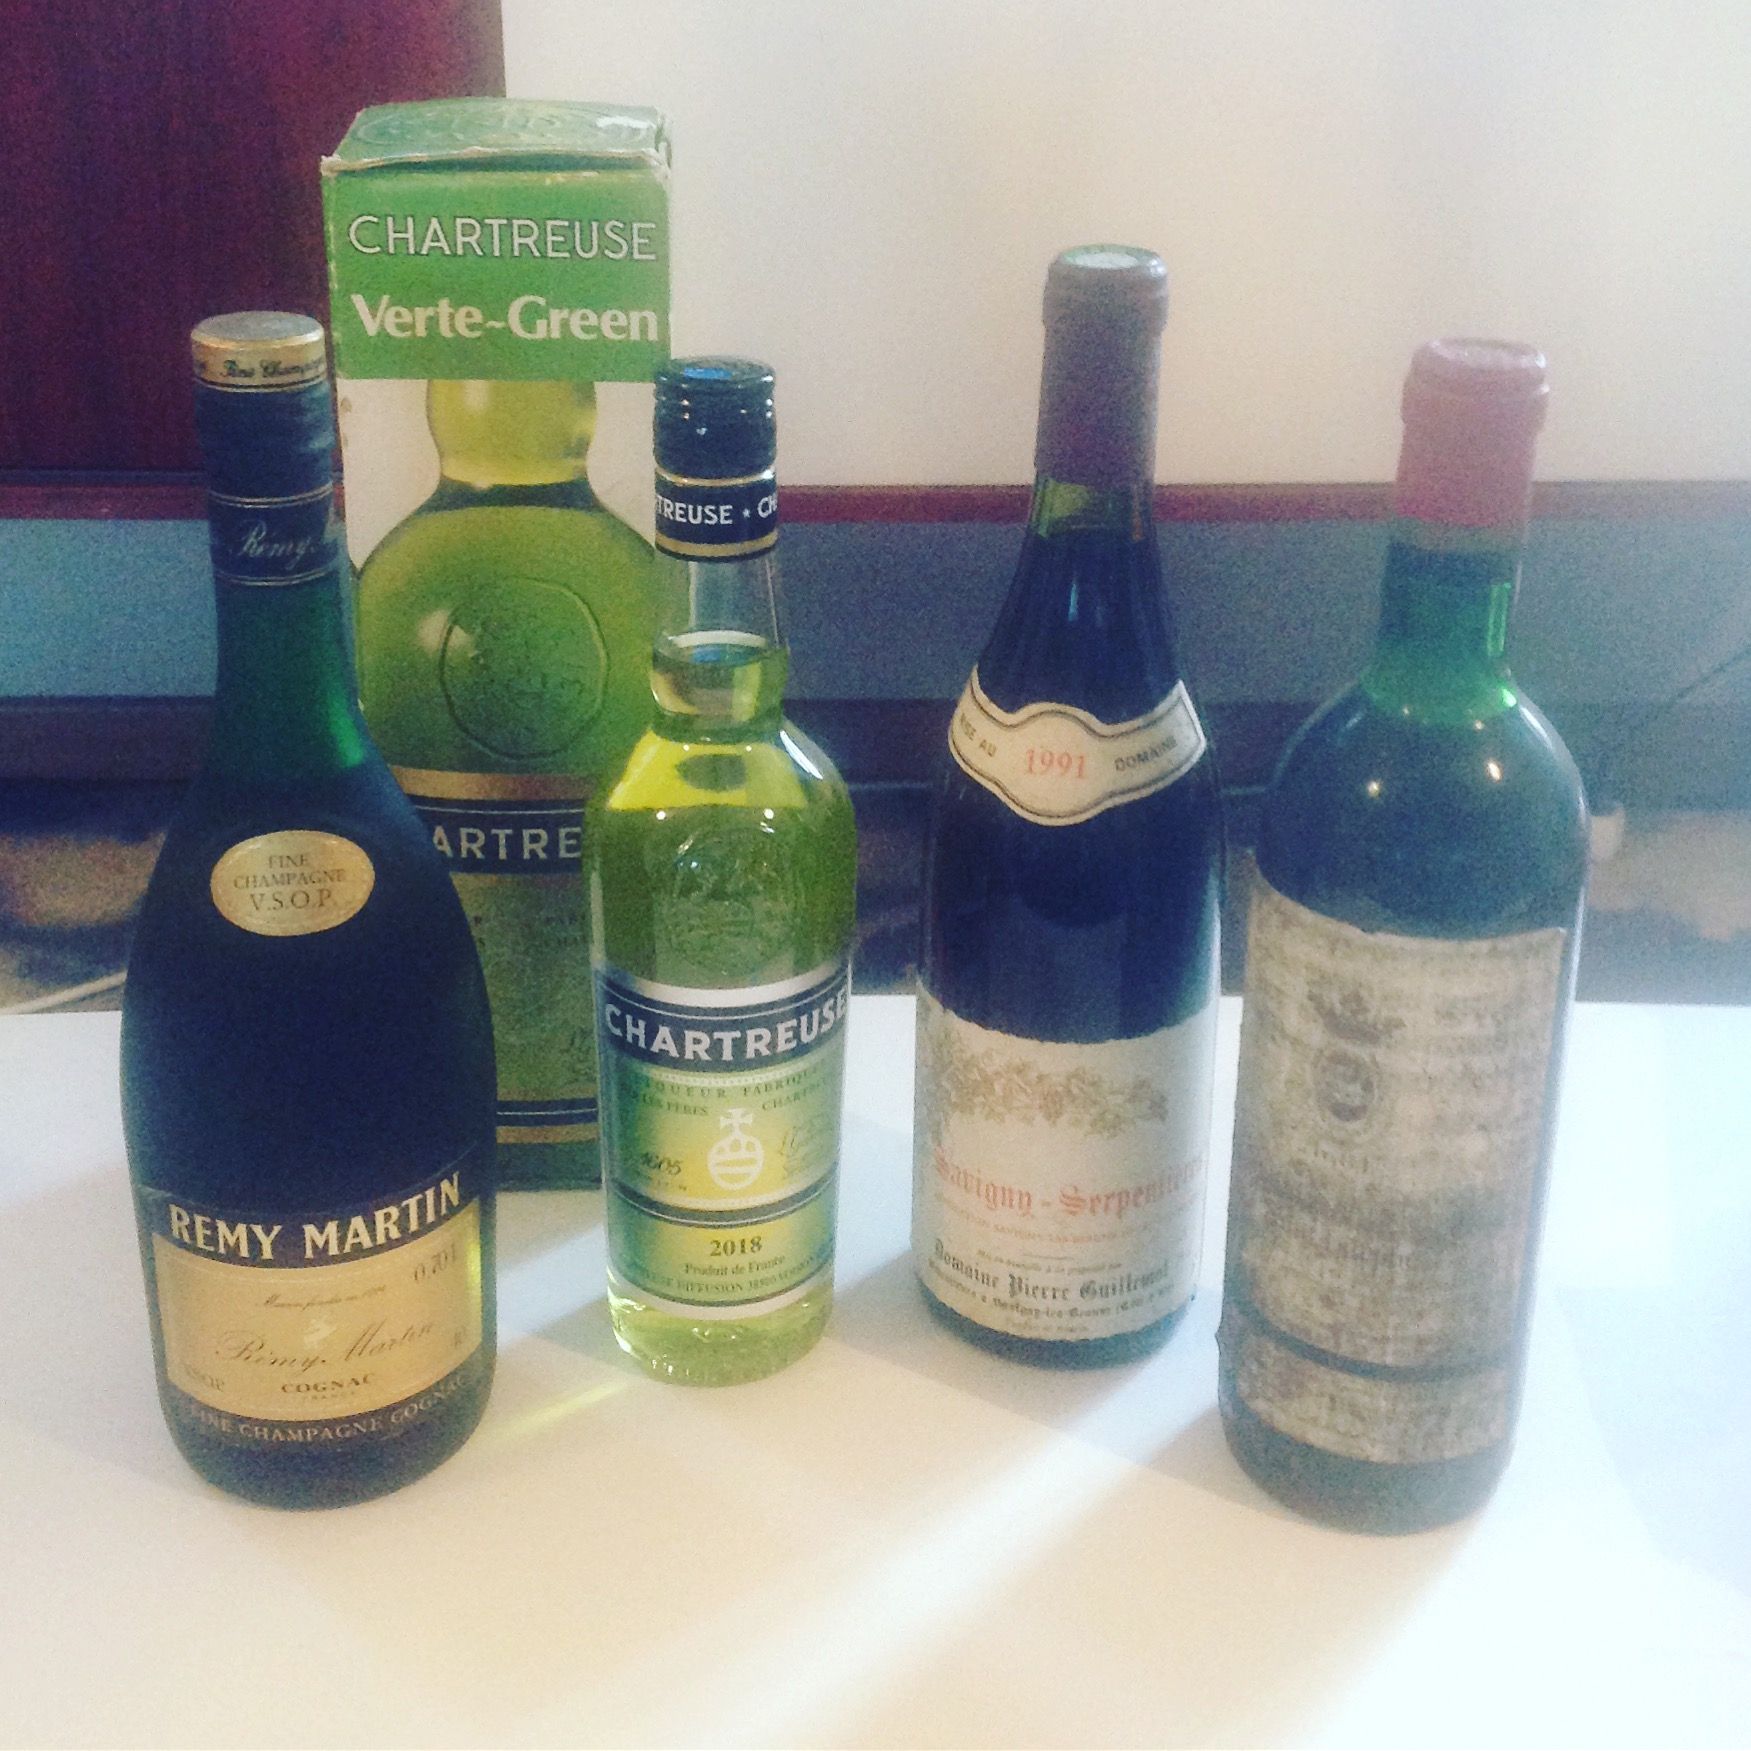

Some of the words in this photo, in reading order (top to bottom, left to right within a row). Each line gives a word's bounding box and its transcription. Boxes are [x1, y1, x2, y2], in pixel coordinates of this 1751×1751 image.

[347, 214, 657, 262] CHARTREUSE
[979, 738, 997, 758] AU
[1024, 748, 1087, 780] 1991
[1114, 735, 1178, 773] DOMAINE
[268, 855, 309, 869] FINE
[233, 868, 346, 890] CHAMPAGNE
[605, 988, 848, 1061] CHARTREUSE
[168, 1203, 283, 1261] REMY
[301, 1170, 461, 1261] MARTIN
[709, 1236, 764, 1257] 2018
[683, 1263, 729, 1277] Produit
[731, 1261, 745, 1274] de
[1008, 1273, 1071, 1301] Pierre
[281, 1373, 376, 1393] COGNAC
[240, 1418, 384, 1442] CHAMPAGNE
